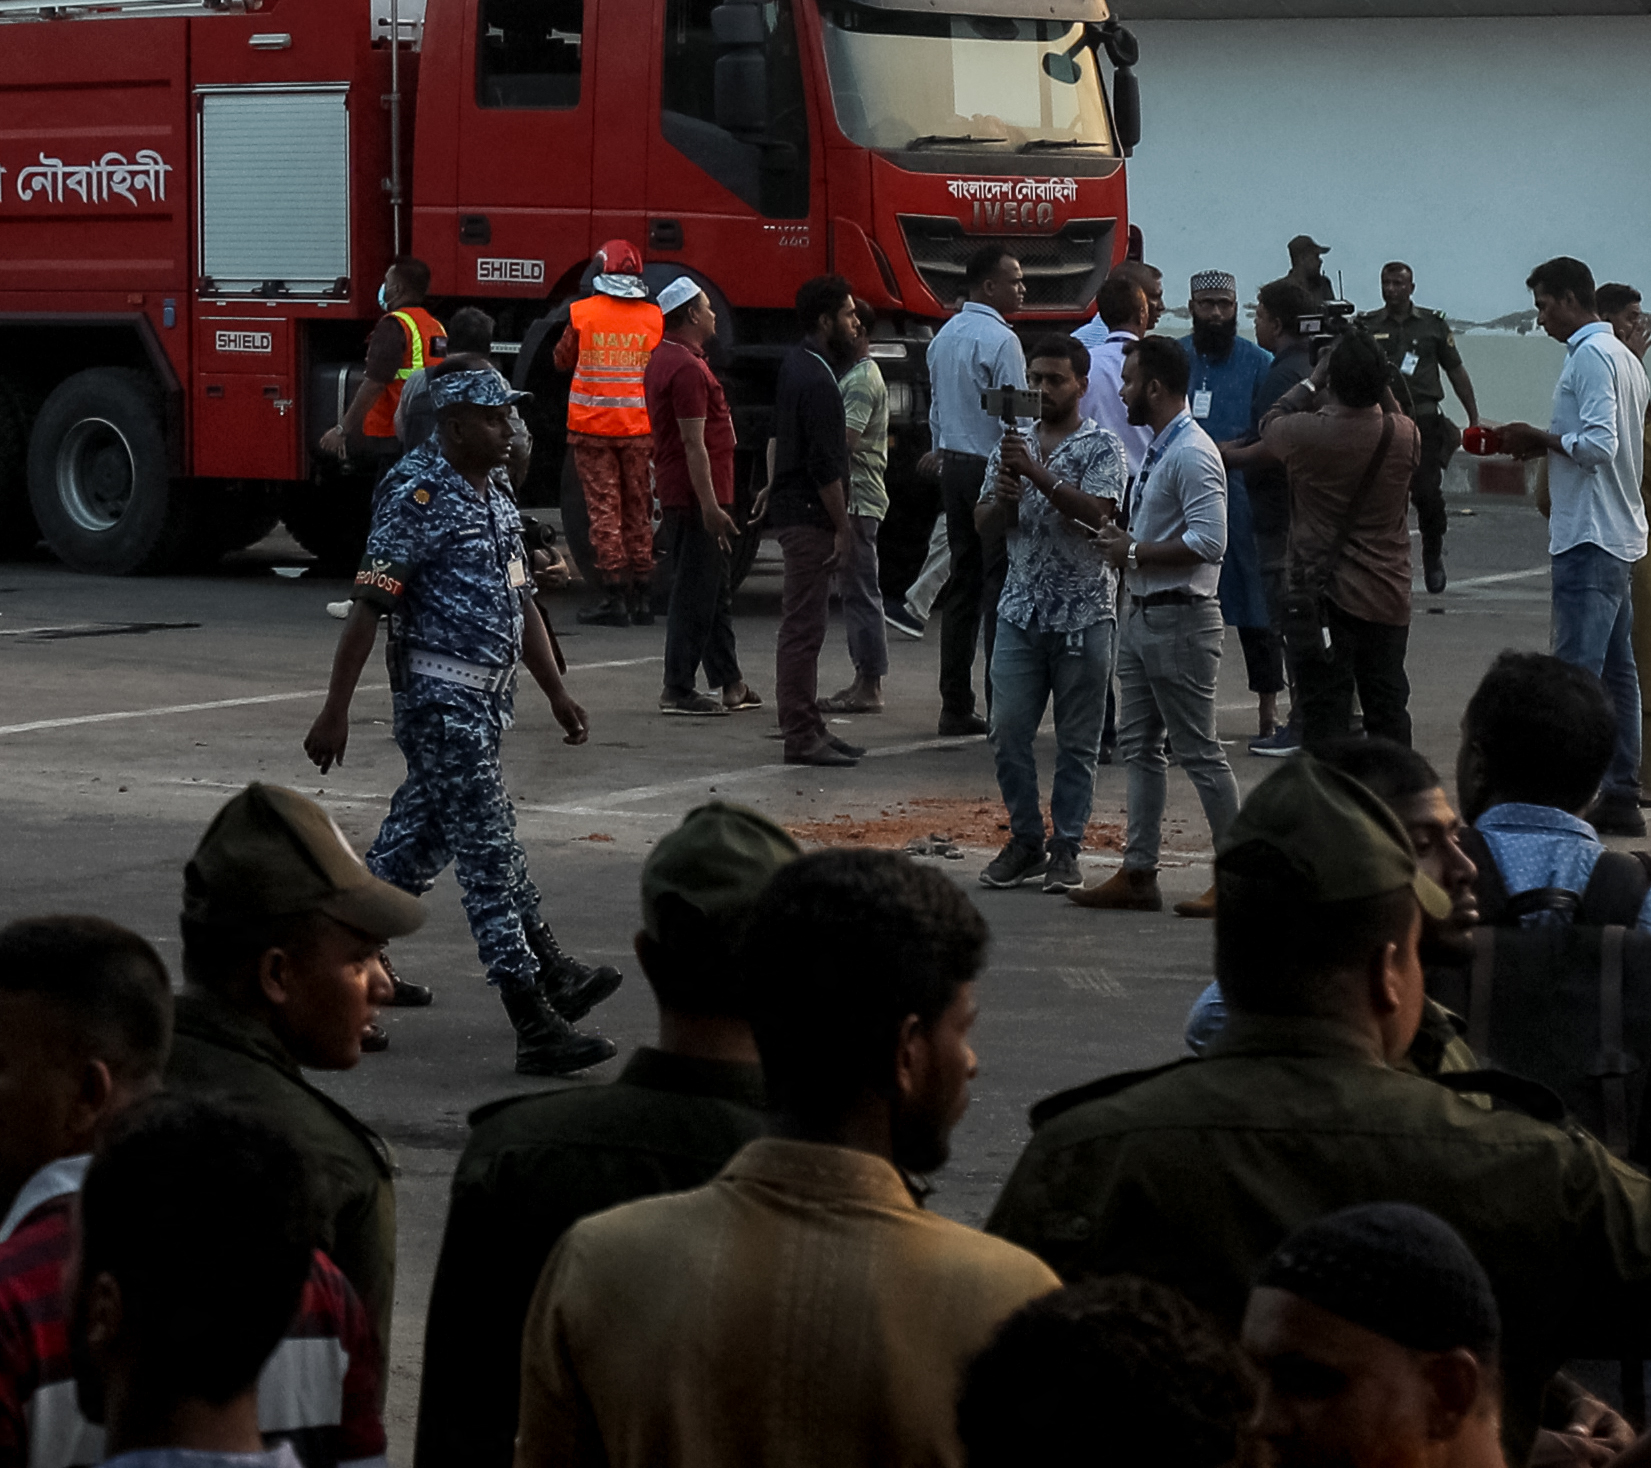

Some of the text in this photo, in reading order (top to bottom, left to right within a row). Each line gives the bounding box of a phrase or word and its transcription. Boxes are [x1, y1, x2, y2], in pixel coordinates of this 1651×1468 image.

[16, 149, 173, 207] নৌবাহিনী
[947, 177, 1078, 204] বাংলাদেশ নৌবাহিনী
[972, 201, 1054, 227] IVECO
[477, 259, 544, 281] SHIELD
[216, 332, 272, 350] SHIELD
[592, 332, 648, 348] NAVY
